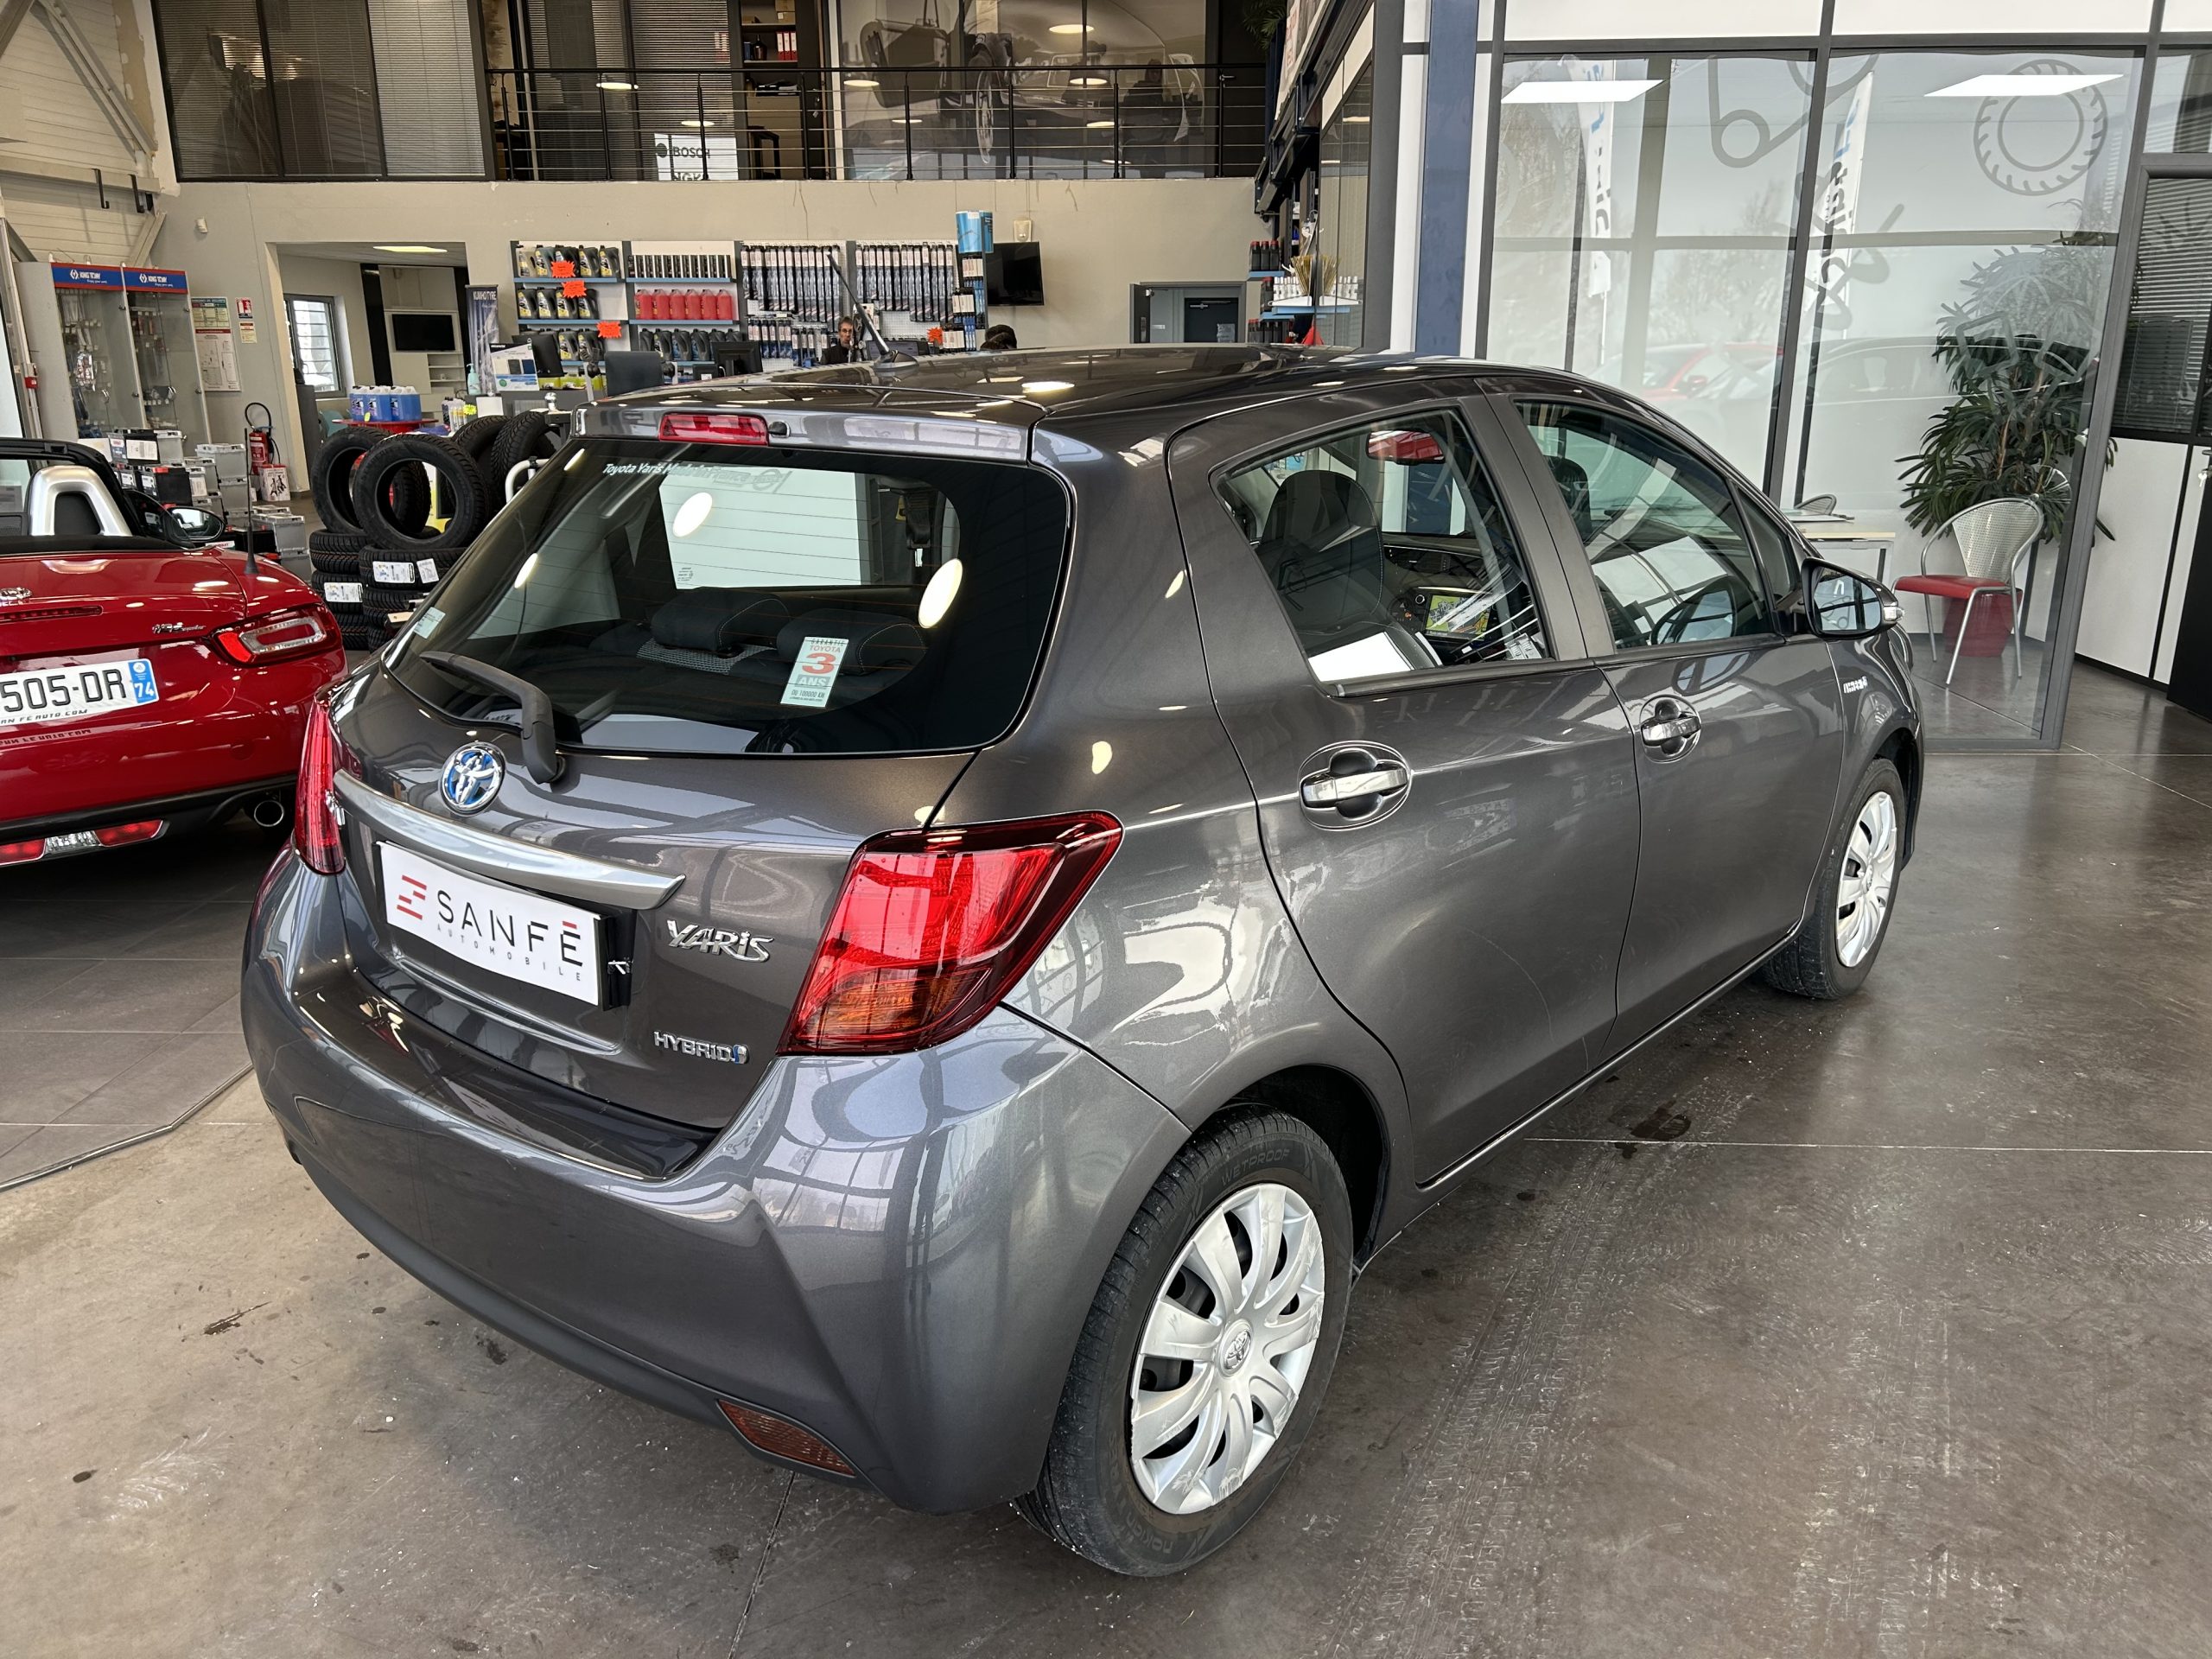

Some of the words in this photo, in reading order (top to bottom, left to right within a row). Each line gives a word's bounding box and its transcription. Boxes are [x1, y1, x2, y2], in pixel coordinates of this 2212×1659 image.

[602, 462, 637, 476] Toyota
[637, 461, 664, 474] Yaris
[809, 645, 842, 653] TOYOTA
[802, 652, 836, 674] 3
[134, 681, 155, 698] 74
[798, 677, 827, 686] ANS
[653, 1031, 732, 1063] HYBRID
